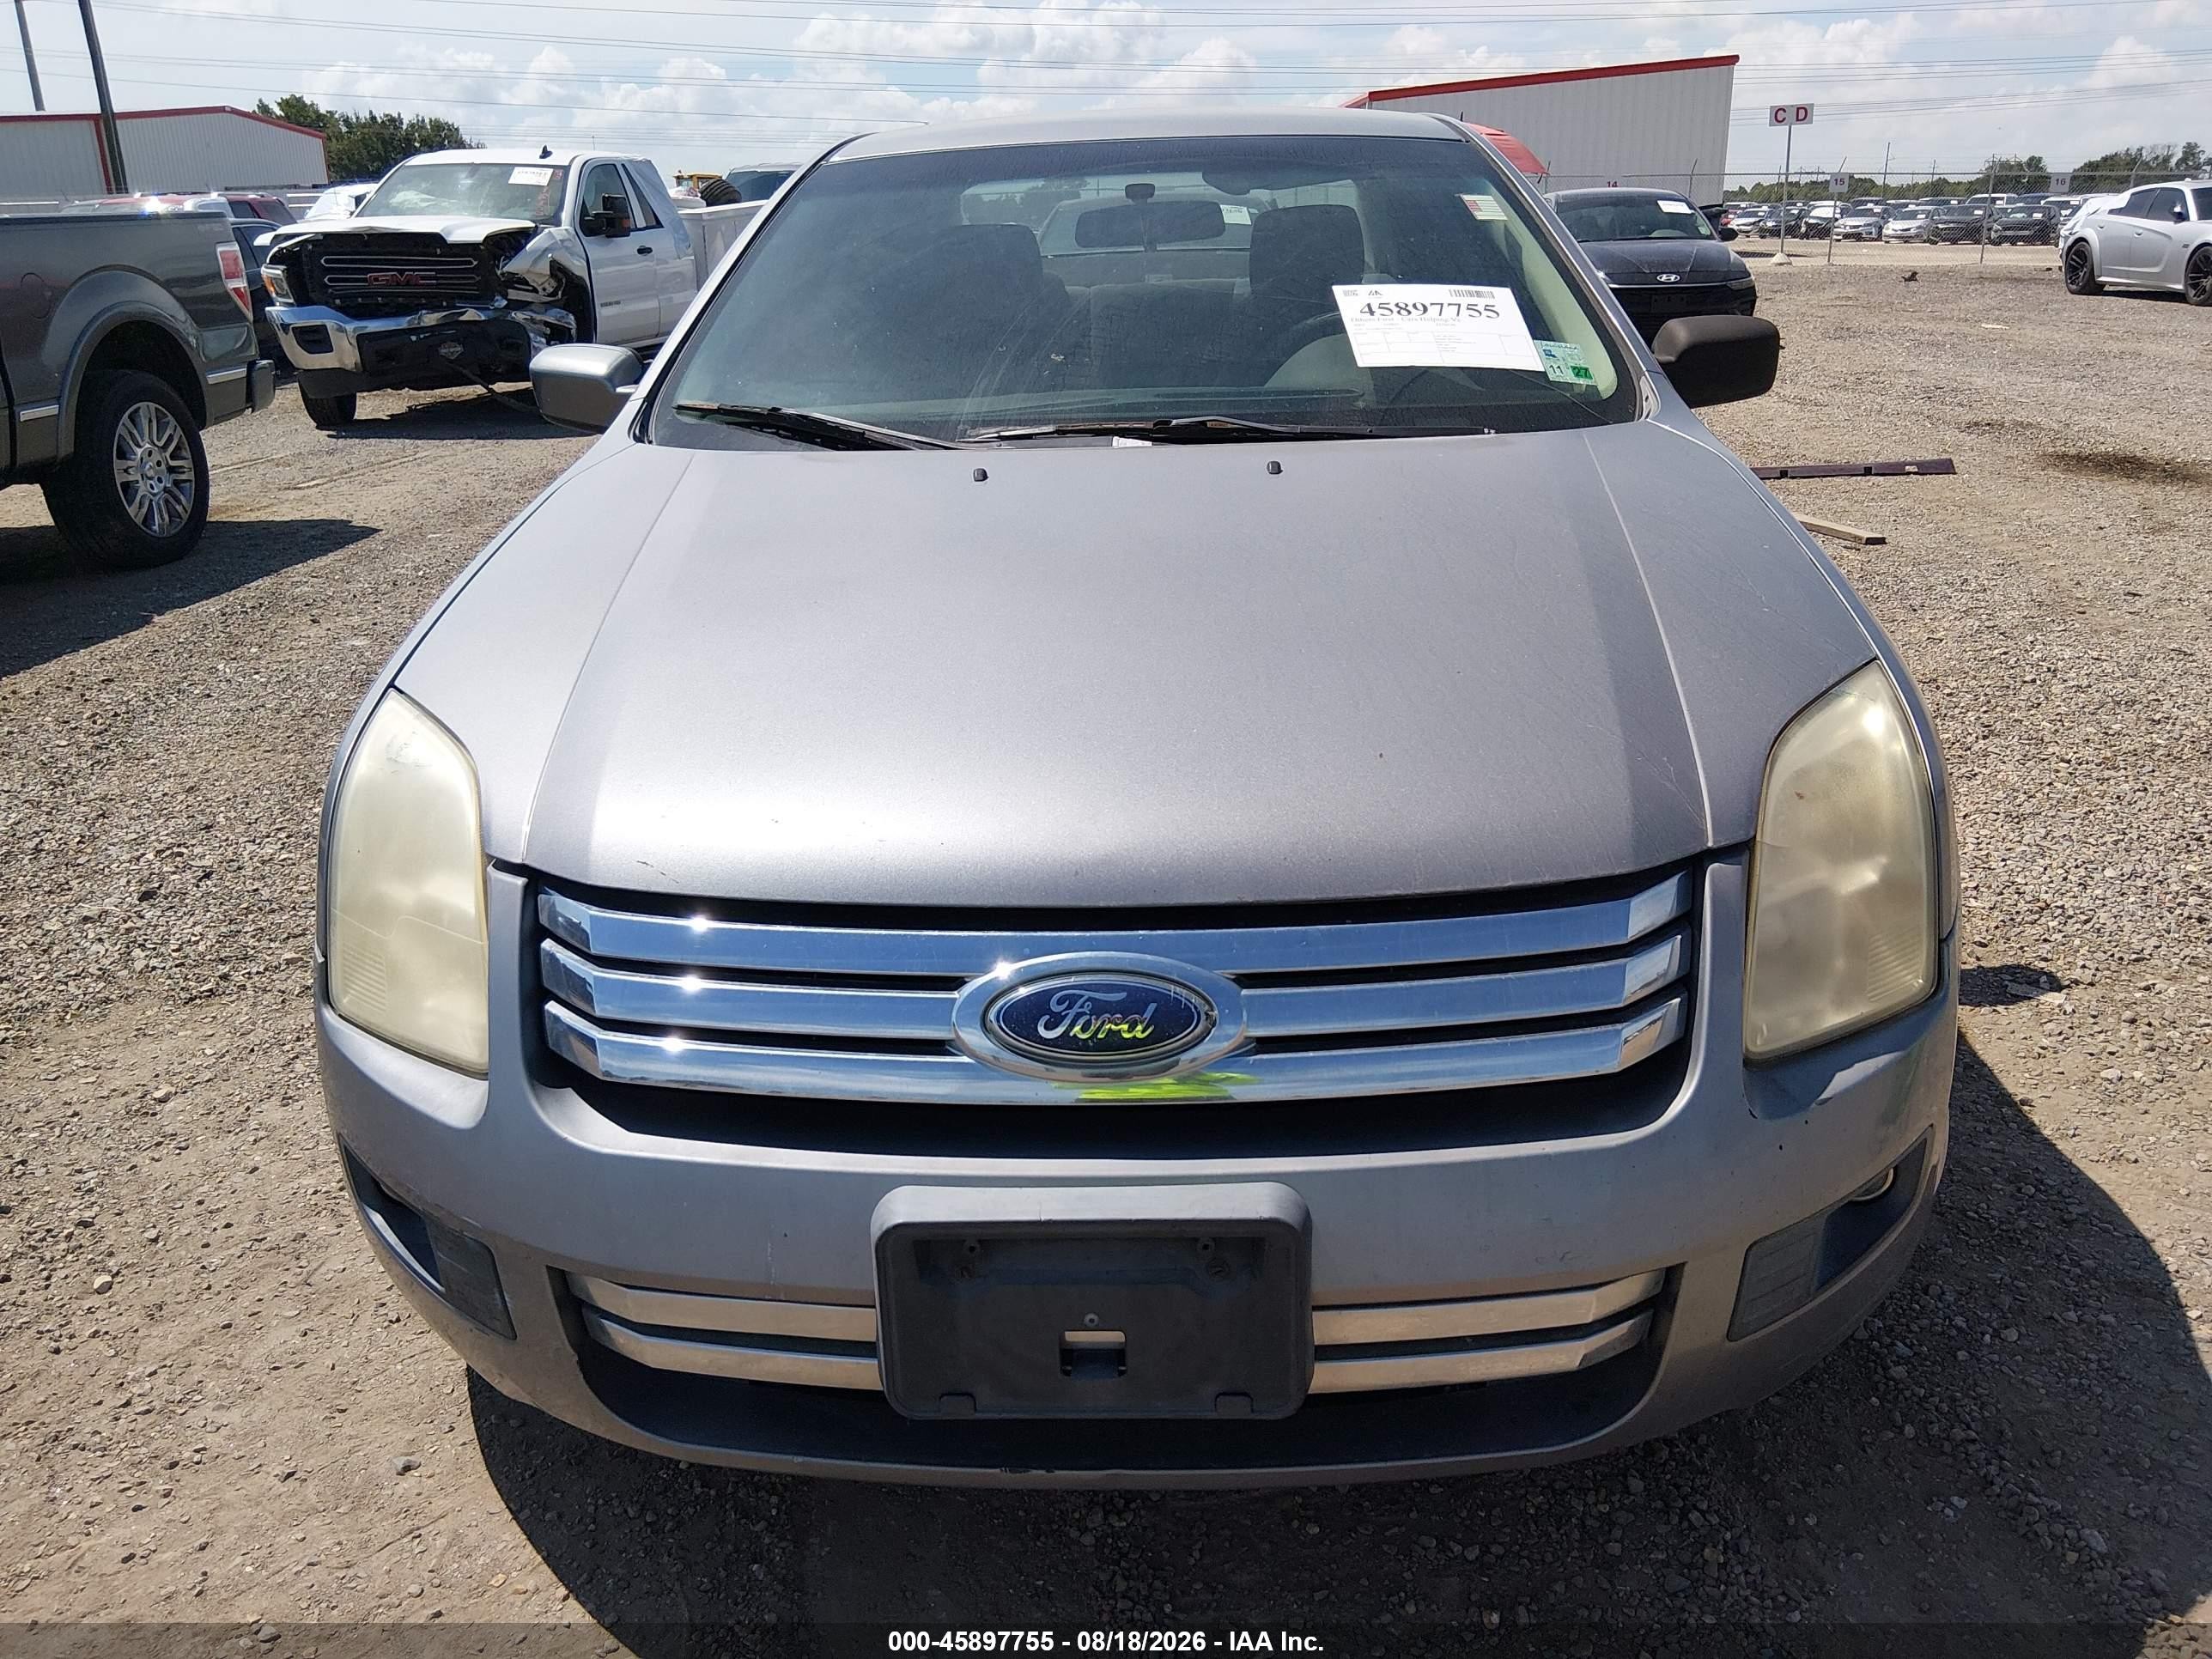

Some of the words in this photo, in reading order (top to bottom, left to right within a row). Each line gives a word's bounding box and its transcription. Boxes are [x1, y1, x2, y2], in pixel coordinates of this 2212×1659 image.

[1774, 107, 1787, 124] C
[1796, 106, 1808, 122] D
[1833, 178, 1844, 186] 15
[2055, 178, 2066, 186] 16
[367, 271, 437, 287] GMC
[1359, 301, 1501, 319] 45897755
[1548, 364, 1565, 375] 11
[1573, 367, 1589, 379] 27
[1036, 989, 1158, 1040] Ford
